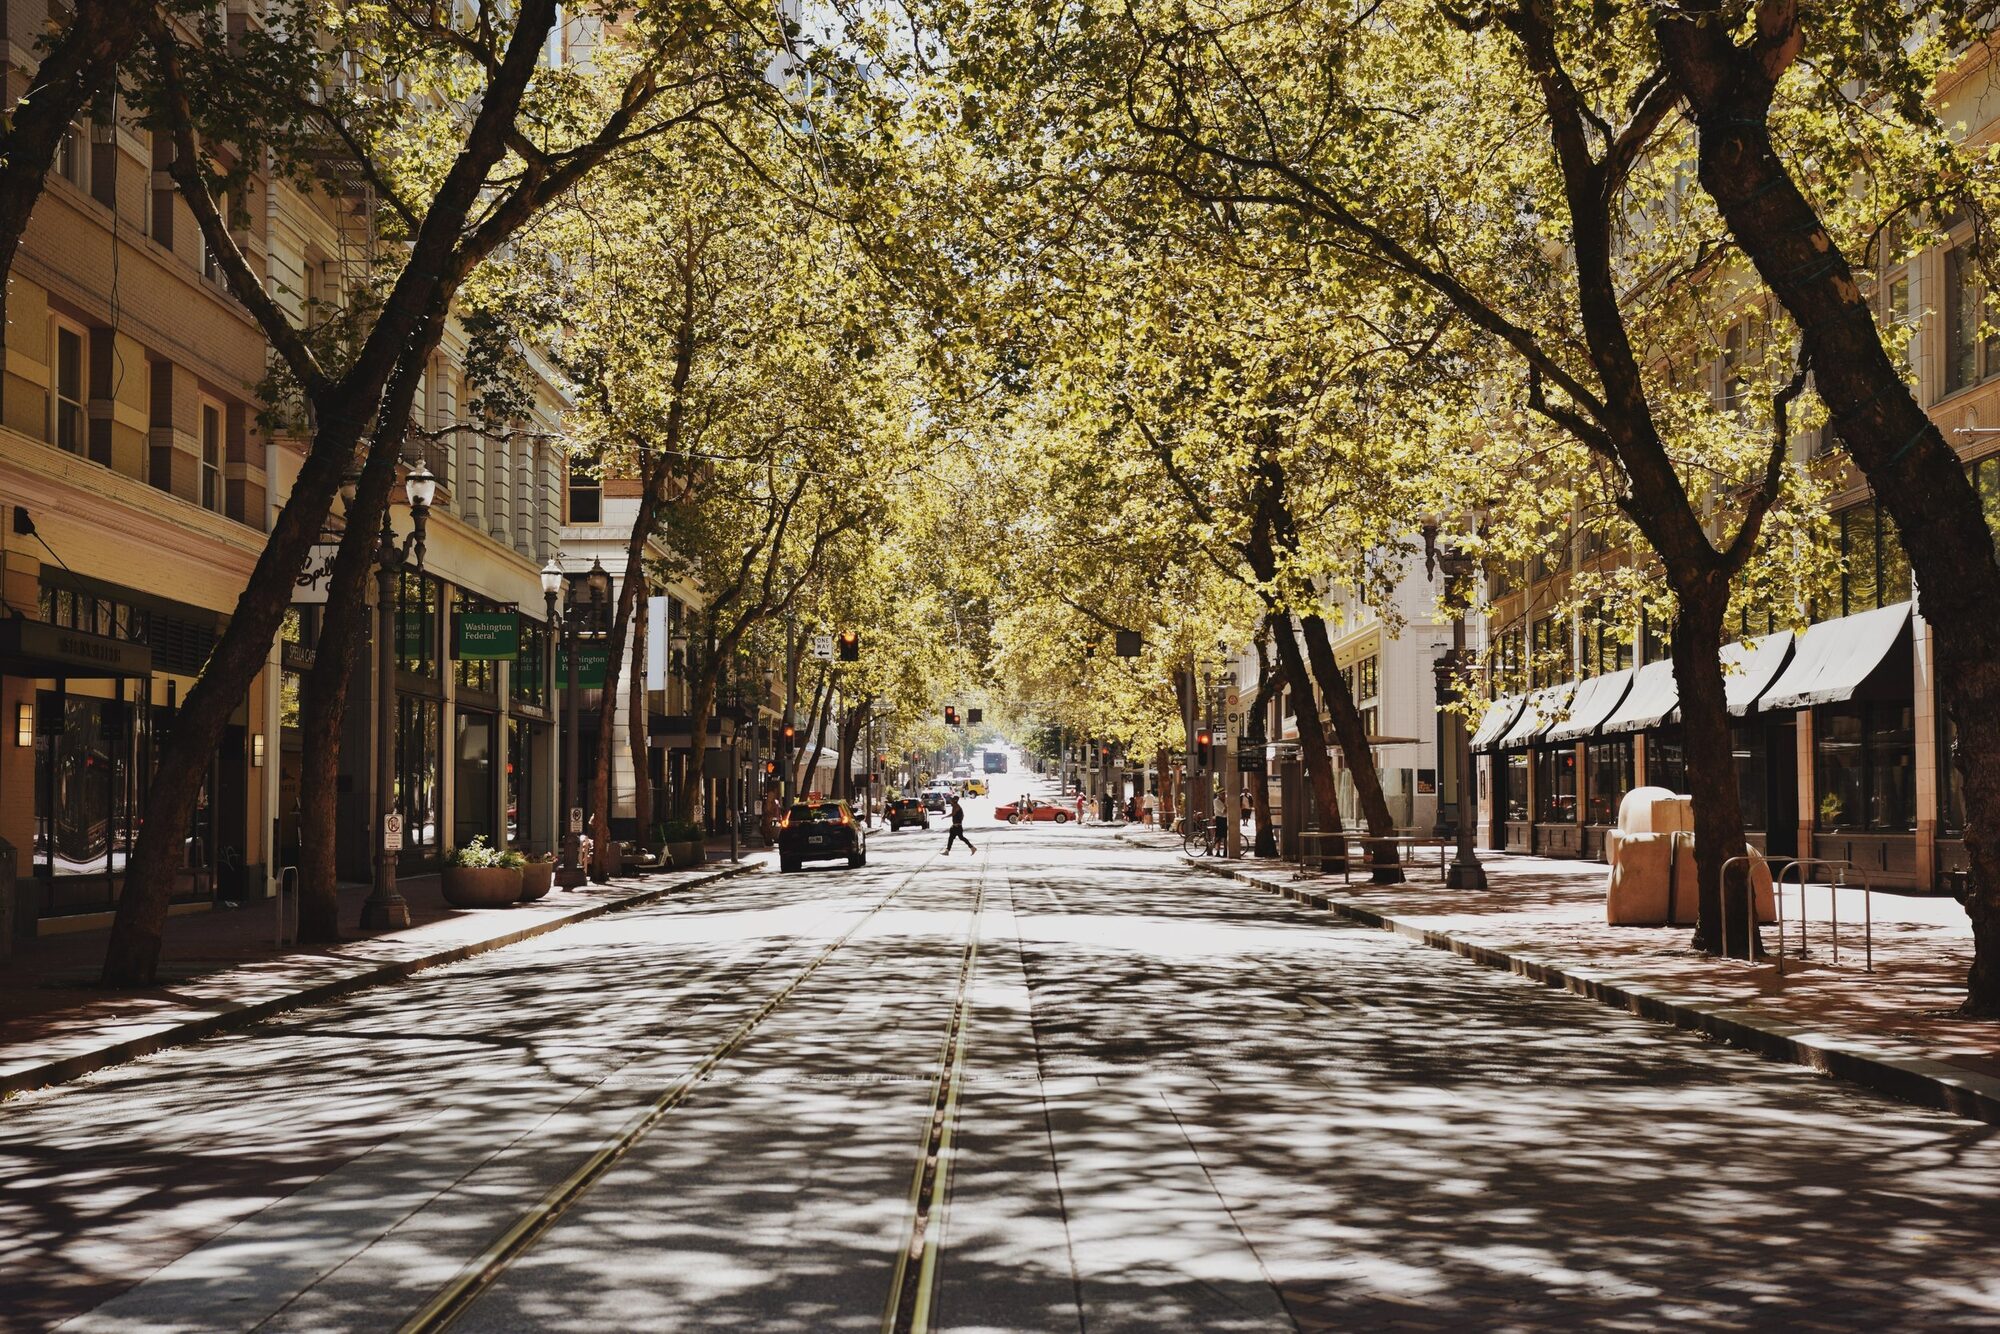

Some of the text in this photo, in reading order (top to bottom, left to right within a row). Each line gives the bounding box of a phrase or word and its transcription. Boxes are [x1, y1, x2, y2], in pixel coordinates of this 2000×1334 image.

[296, 556, 335, 591] Spell
[465, 622, 512, 632] Washington
[465, 632, 497, 640] Federal.
[289, 644, 316, 664] SPELLA CAFF
[561, 655, 605, 664] Wington
[561, 663, 592, 671] Feral.
